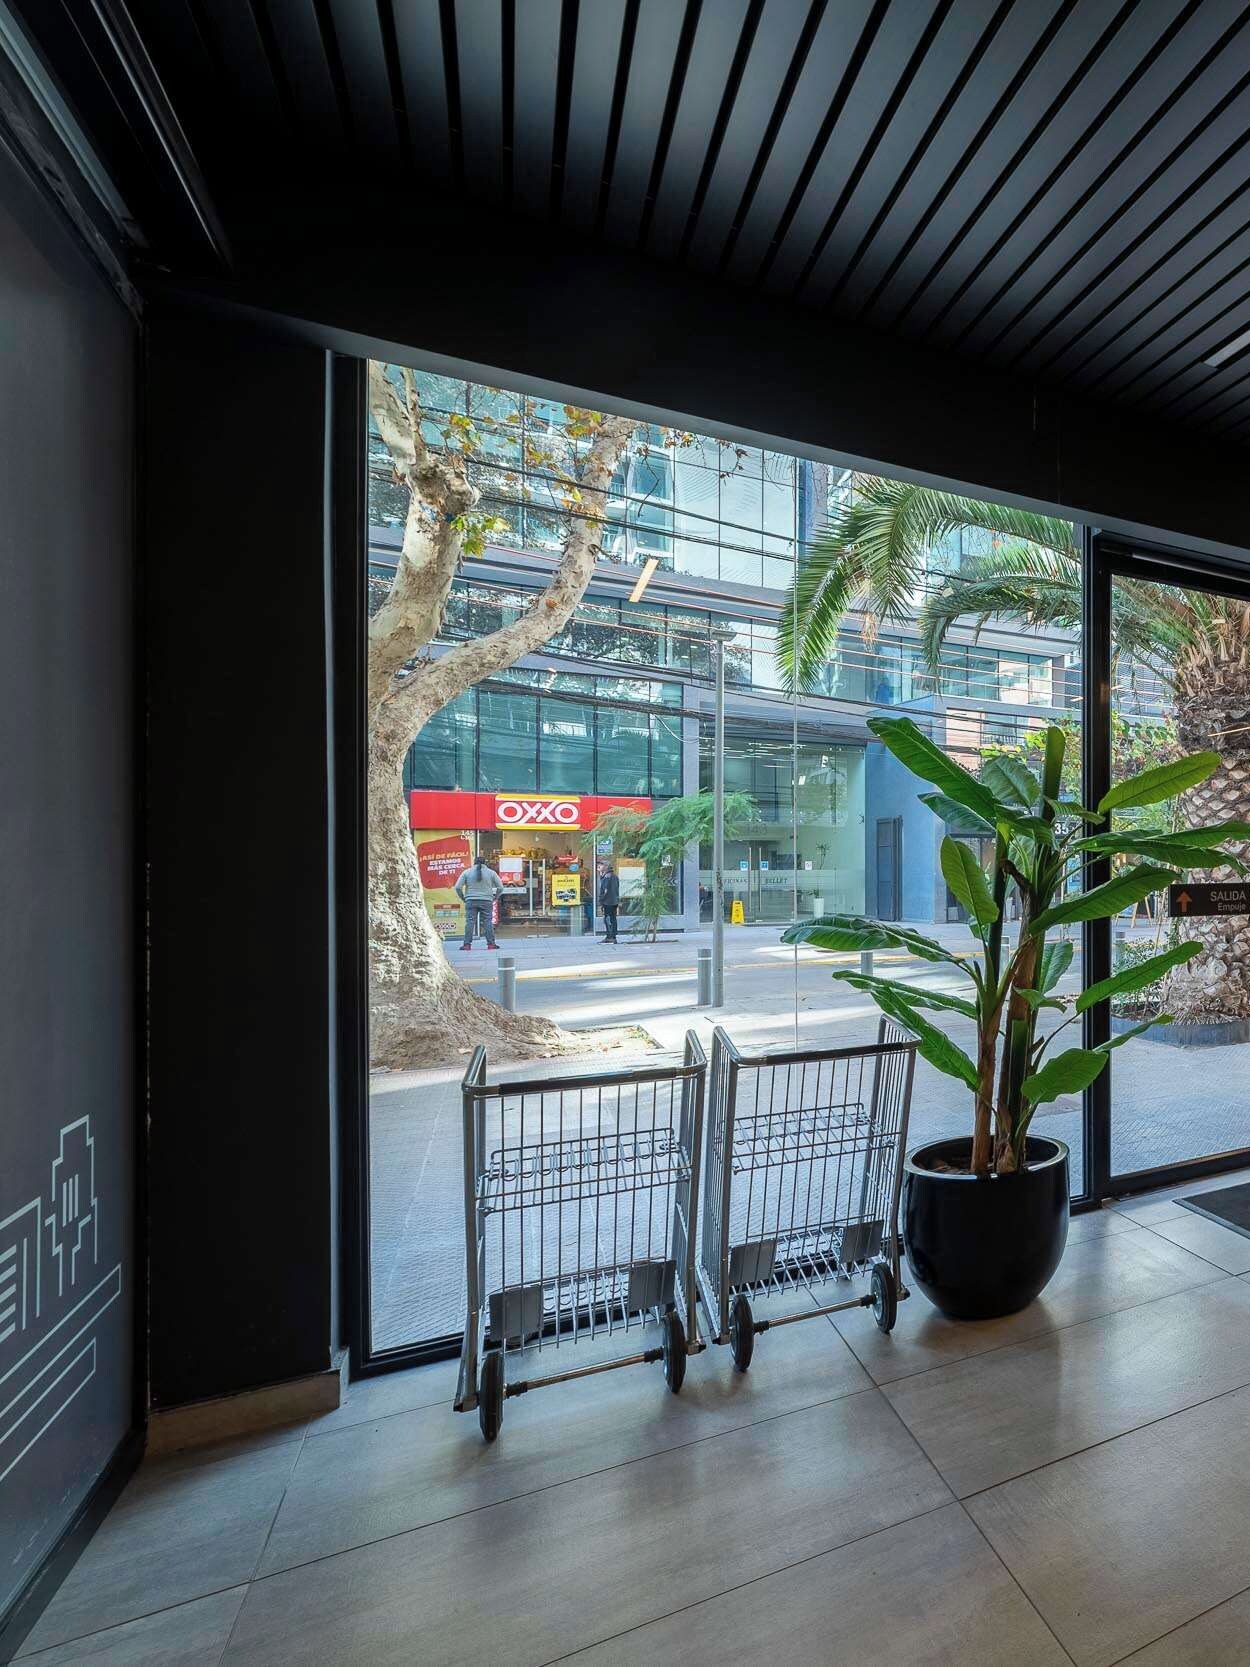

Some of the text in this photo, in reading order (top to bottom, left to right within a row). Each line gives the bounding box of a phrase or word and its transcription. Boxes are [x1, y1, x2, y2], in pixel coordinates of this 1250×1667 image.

[497, 801, 579, 823] OXXO
[429, 858, 462, 866] ESTAMOS
[443, 862, 464, 870] CERCA
[1210, 891, 1246, 902] SALIDA
[1218, 903, 1246, 912] Empuje
